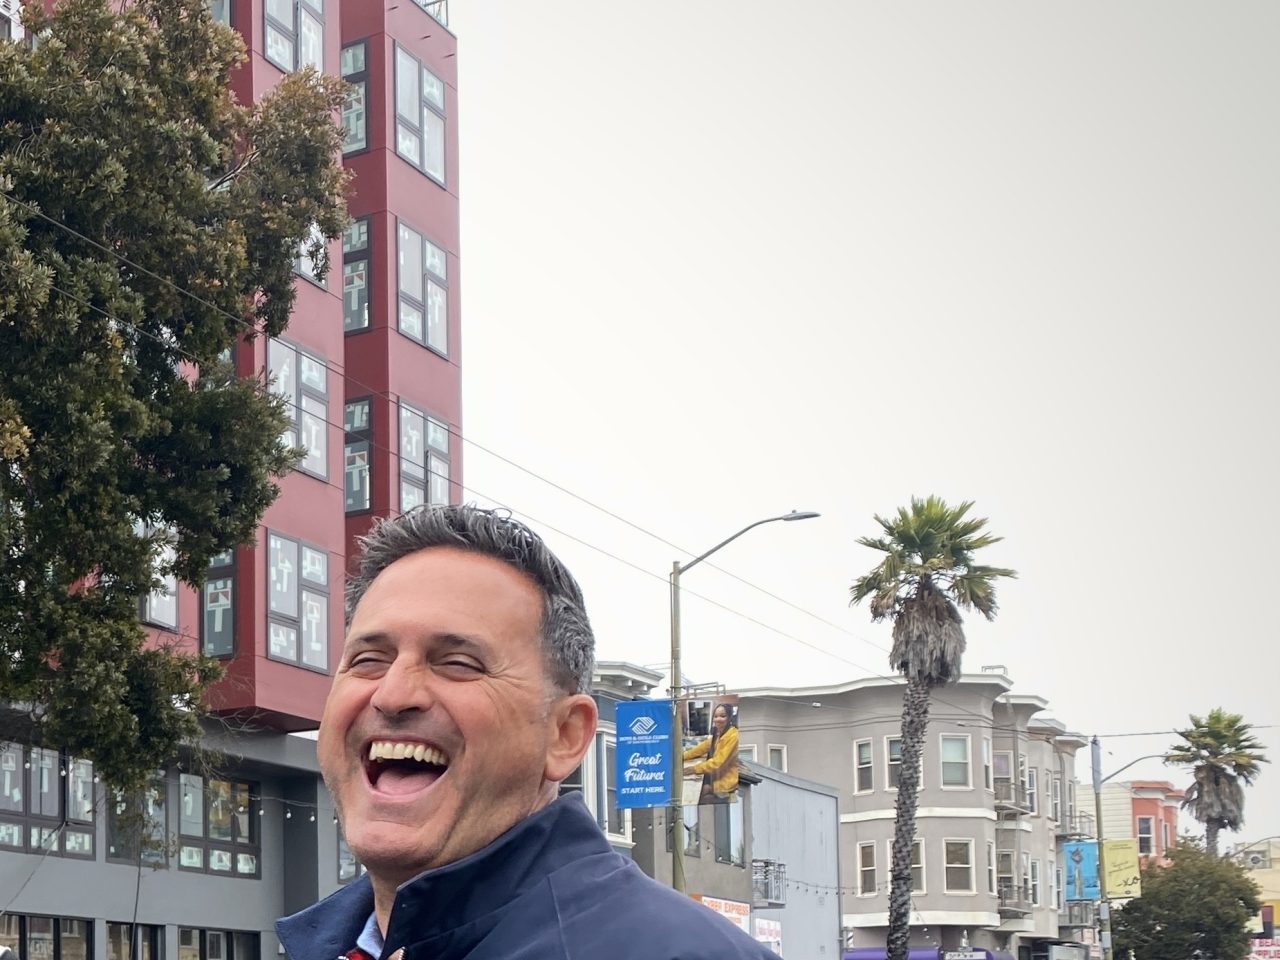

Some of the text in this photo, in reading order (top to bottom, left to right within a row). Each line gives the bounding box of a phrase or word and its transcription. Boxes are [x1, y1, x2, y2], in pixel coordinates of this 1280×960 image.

[629, 752, 663, 768] Great
[623, 768, 666, 783] Futures
[621, 786, 644, 795] START
